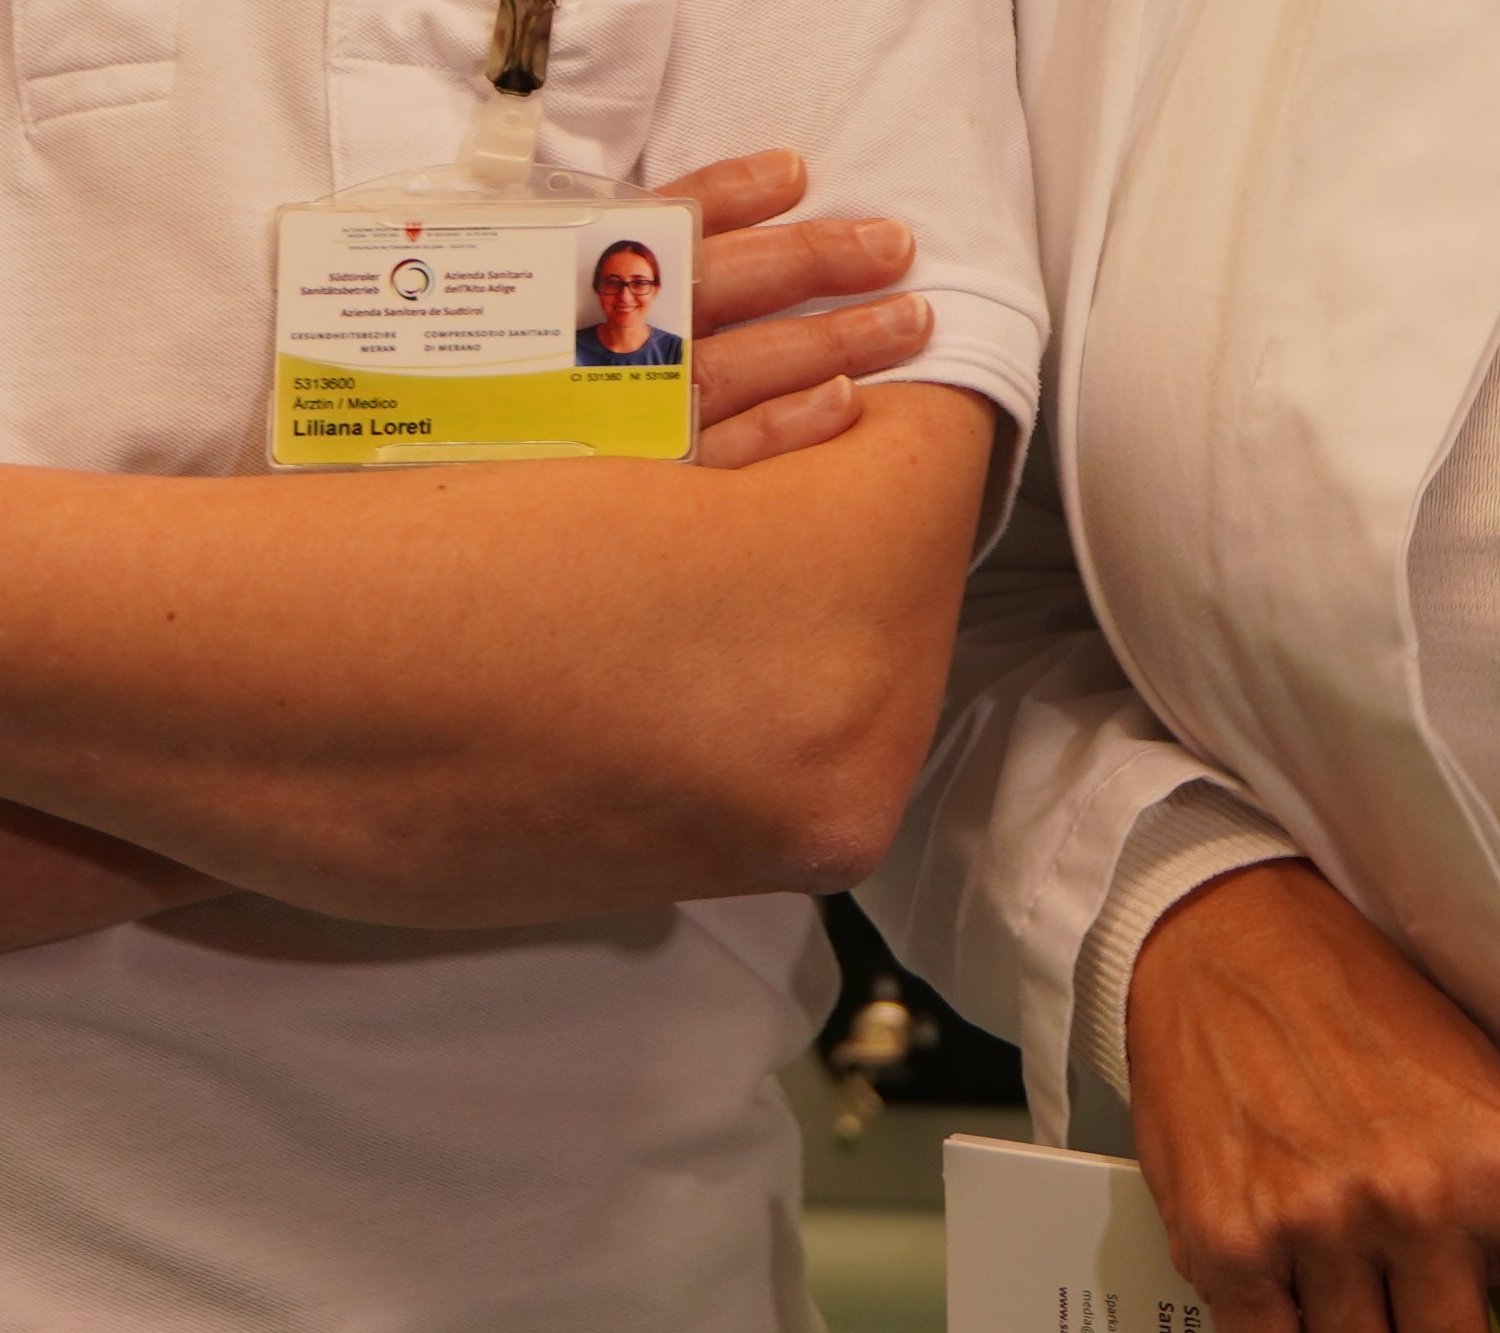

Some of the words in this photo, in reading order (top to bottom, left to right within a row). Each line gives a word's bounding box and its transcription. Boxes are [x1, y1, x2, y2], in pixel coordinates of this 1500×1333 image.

[328, 271, 380, 282] Südtiroler
[444, 271, 485, 281] Azienda
[488, 269, 533, 280] Sanitaria
[301, 285, 380, 296] Sanitätsbetrieb
[488, 283, 517, 295] Adige
[341, 308, 382, 318] Azienda
[429, 307, 442, 316] de
[347, 396, 398, 409] Medico
[293, 419, 363, 436] Liliana
[371, 418, 432, 435] Loreti
